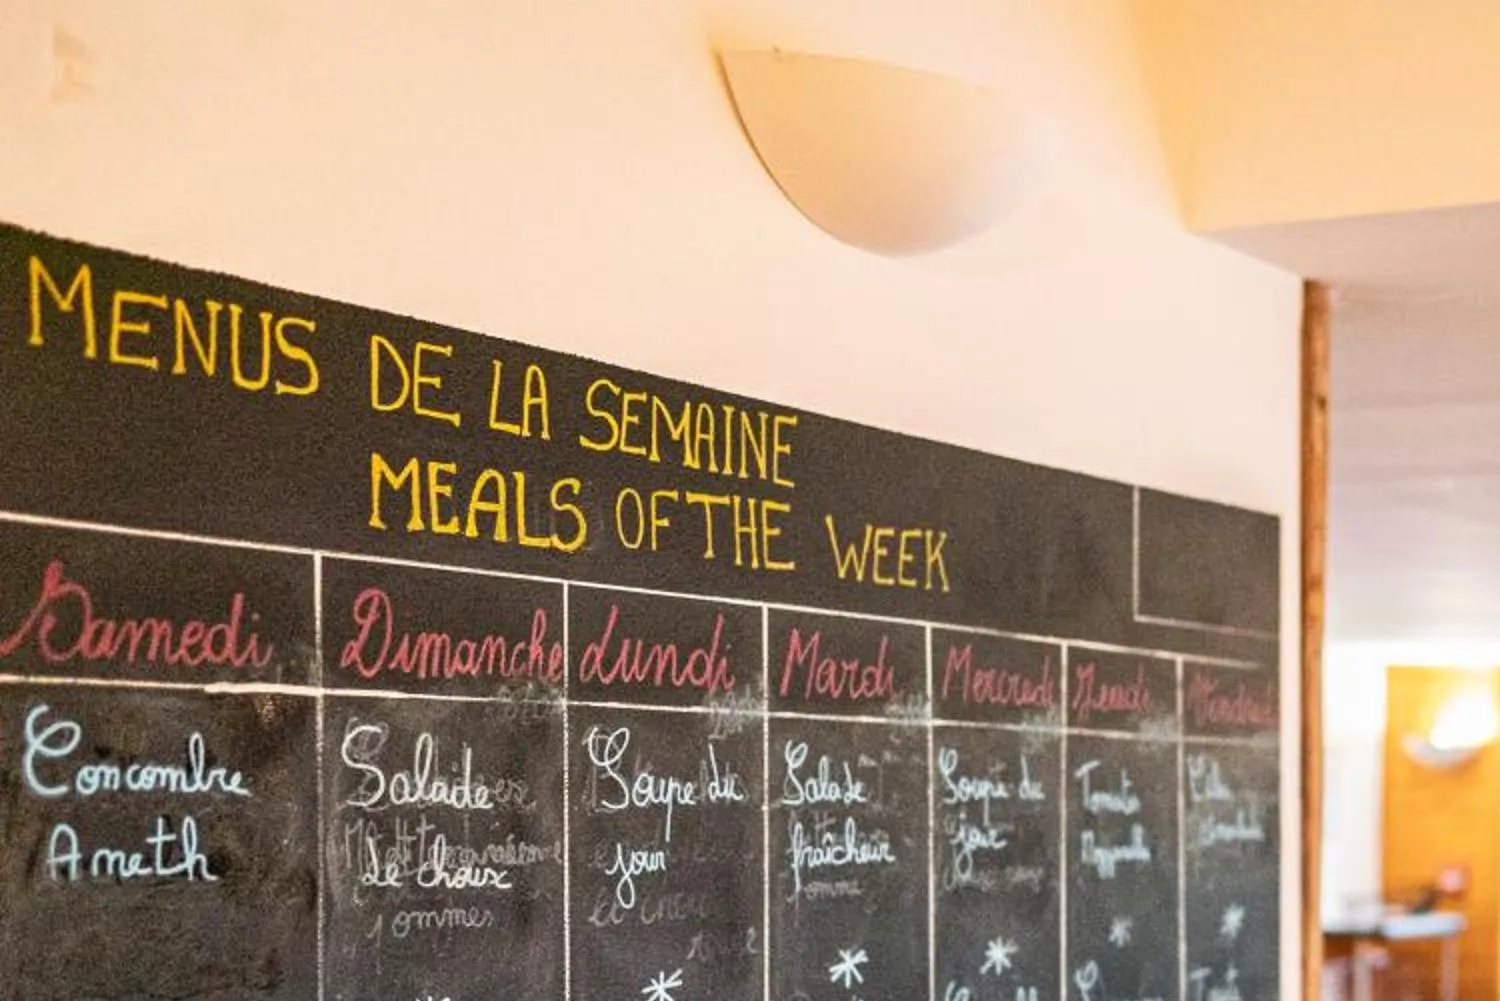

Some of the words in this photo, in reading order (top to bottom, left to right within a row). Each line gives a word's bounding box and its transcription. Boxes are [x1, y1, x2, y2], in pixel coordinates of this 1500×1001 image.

[28, 255, 319, 395] MENUS
[370, 333, 460, 427] DE
[488, 358, 550, 440] LA
[580, 379, 797, 488] SEMAINE
[369, 452, 587, 552] MEALS
[615, 488, 679, 551] OF
[686, 491, 795, 571] THE
[825, 514, 950, 592] WEEK
[0, 558, 273, 667] Samedi
[341, 587, 562, 682] Dimanche
[580, 604, 736, 692] Lundi
[779, 628, 896, 699] Mardi
[23, 704, 252, 796] Concombre
[588, 726, 697, 842] Soupe
[708, 743, 744, 801] du
[782, 740, 867, 806] Salade
[605, 843, 666, 909] jour
